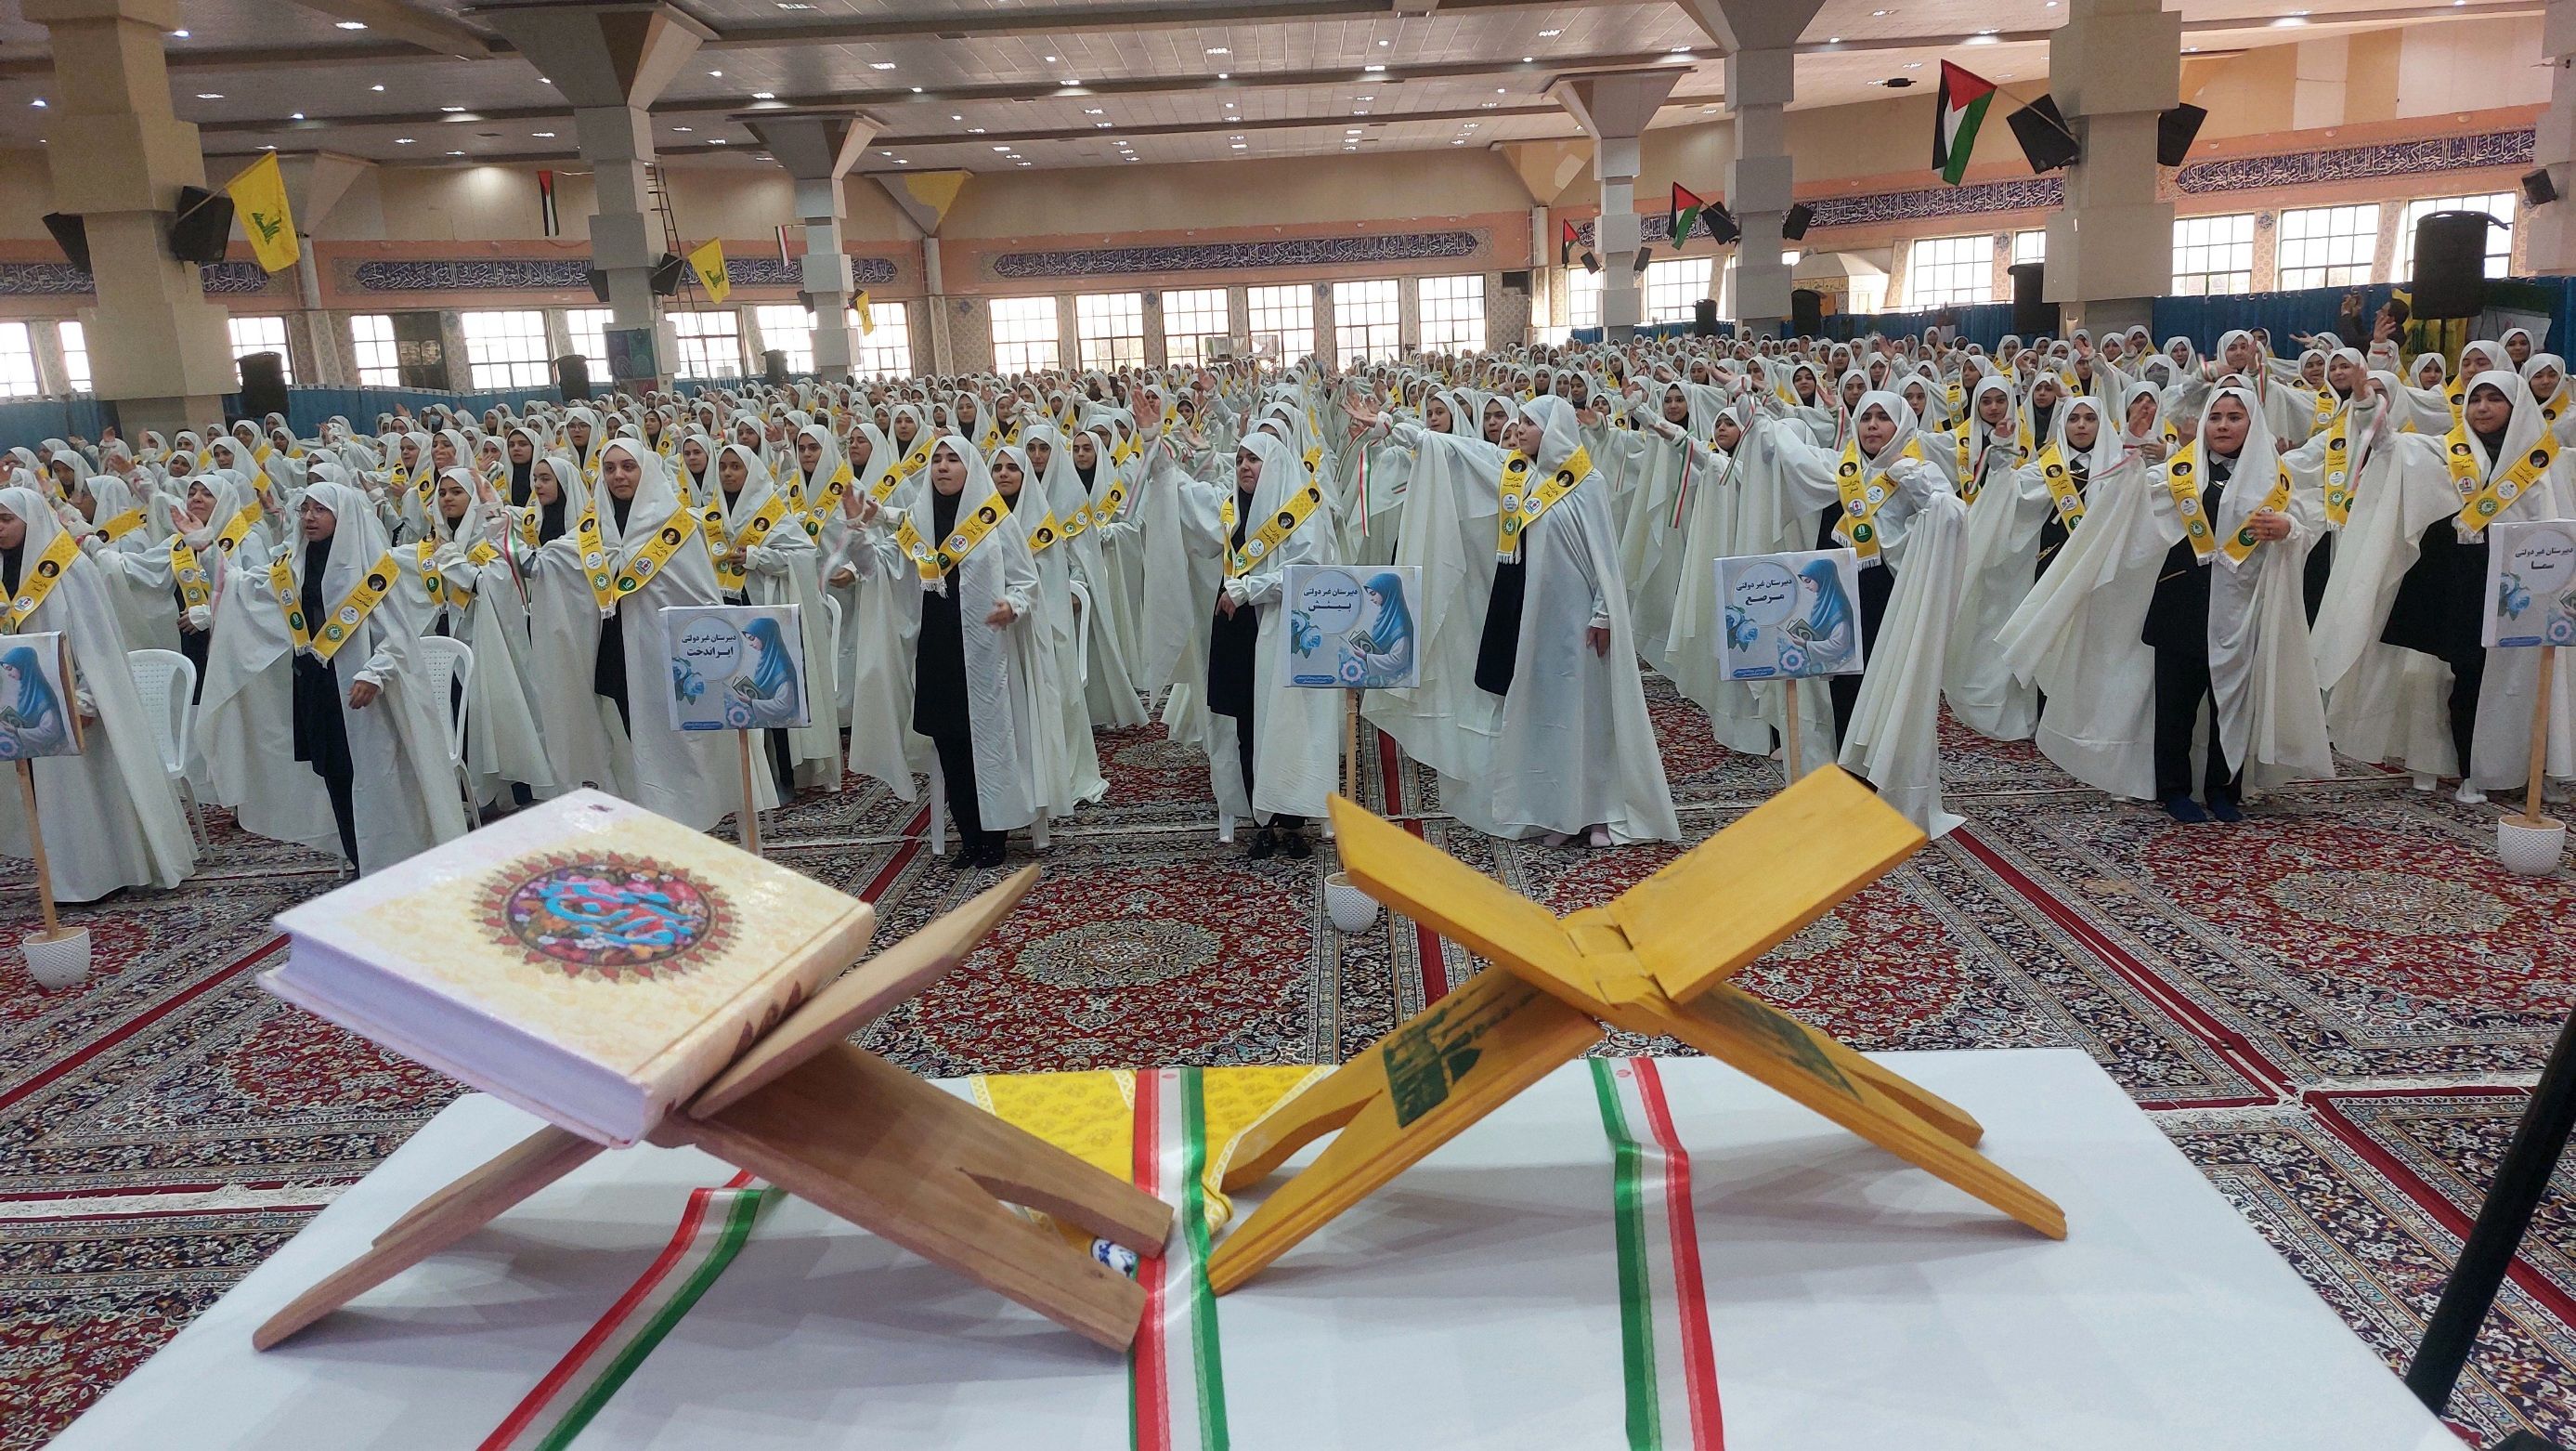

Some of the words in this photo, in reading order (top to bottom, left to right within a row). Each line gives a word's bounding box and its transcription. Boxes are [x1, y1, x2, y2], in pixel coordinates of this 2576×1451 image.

[1308, 600, 1352, 613] بینش
[1745, 593, 1785, 607] مرصع
[686, 646, 735, 659] ایراندخت
